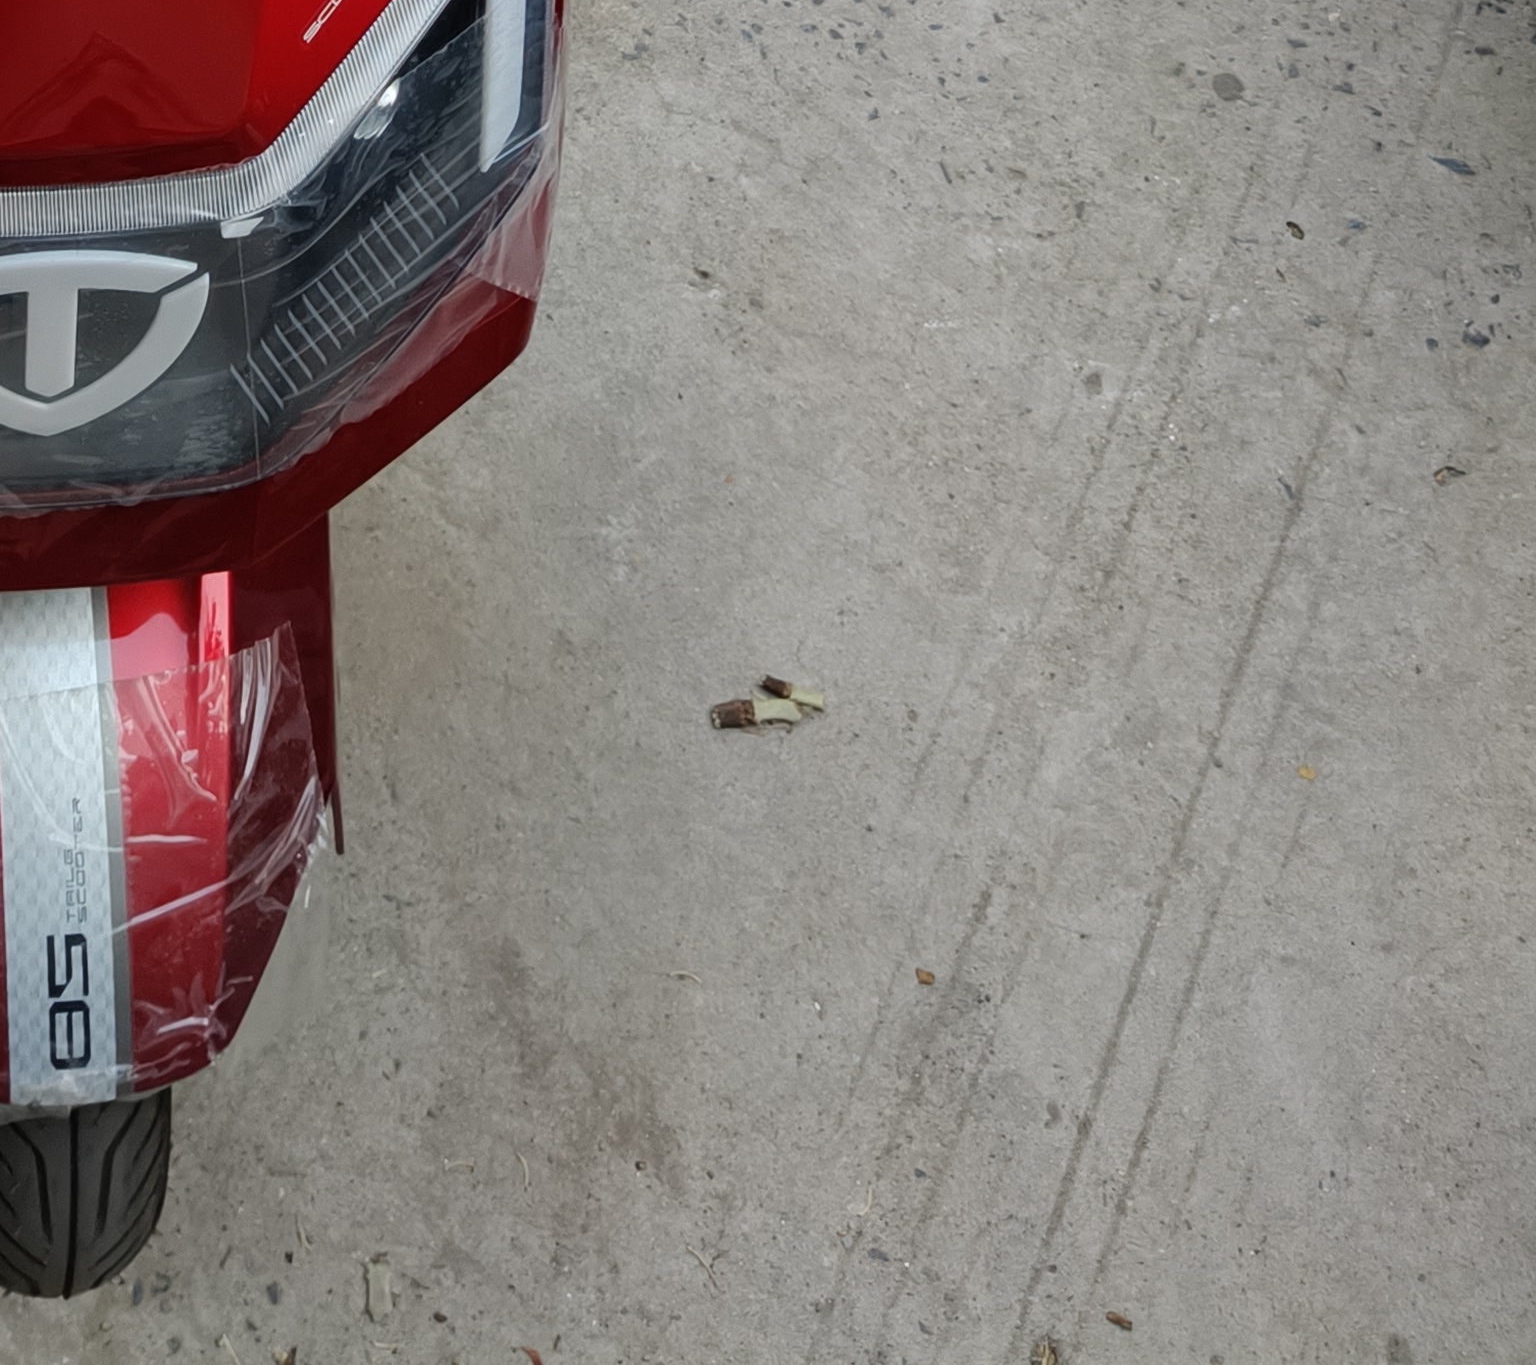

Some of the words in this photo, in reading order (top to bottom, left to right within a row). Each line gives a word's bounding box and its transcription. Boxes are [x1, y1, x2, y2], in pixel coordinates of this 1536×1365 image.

[65, 847, 77, 924] TAILG
[71, 796, 88, 925] SCOOTER
[46, 932, 92, 1070] 85
